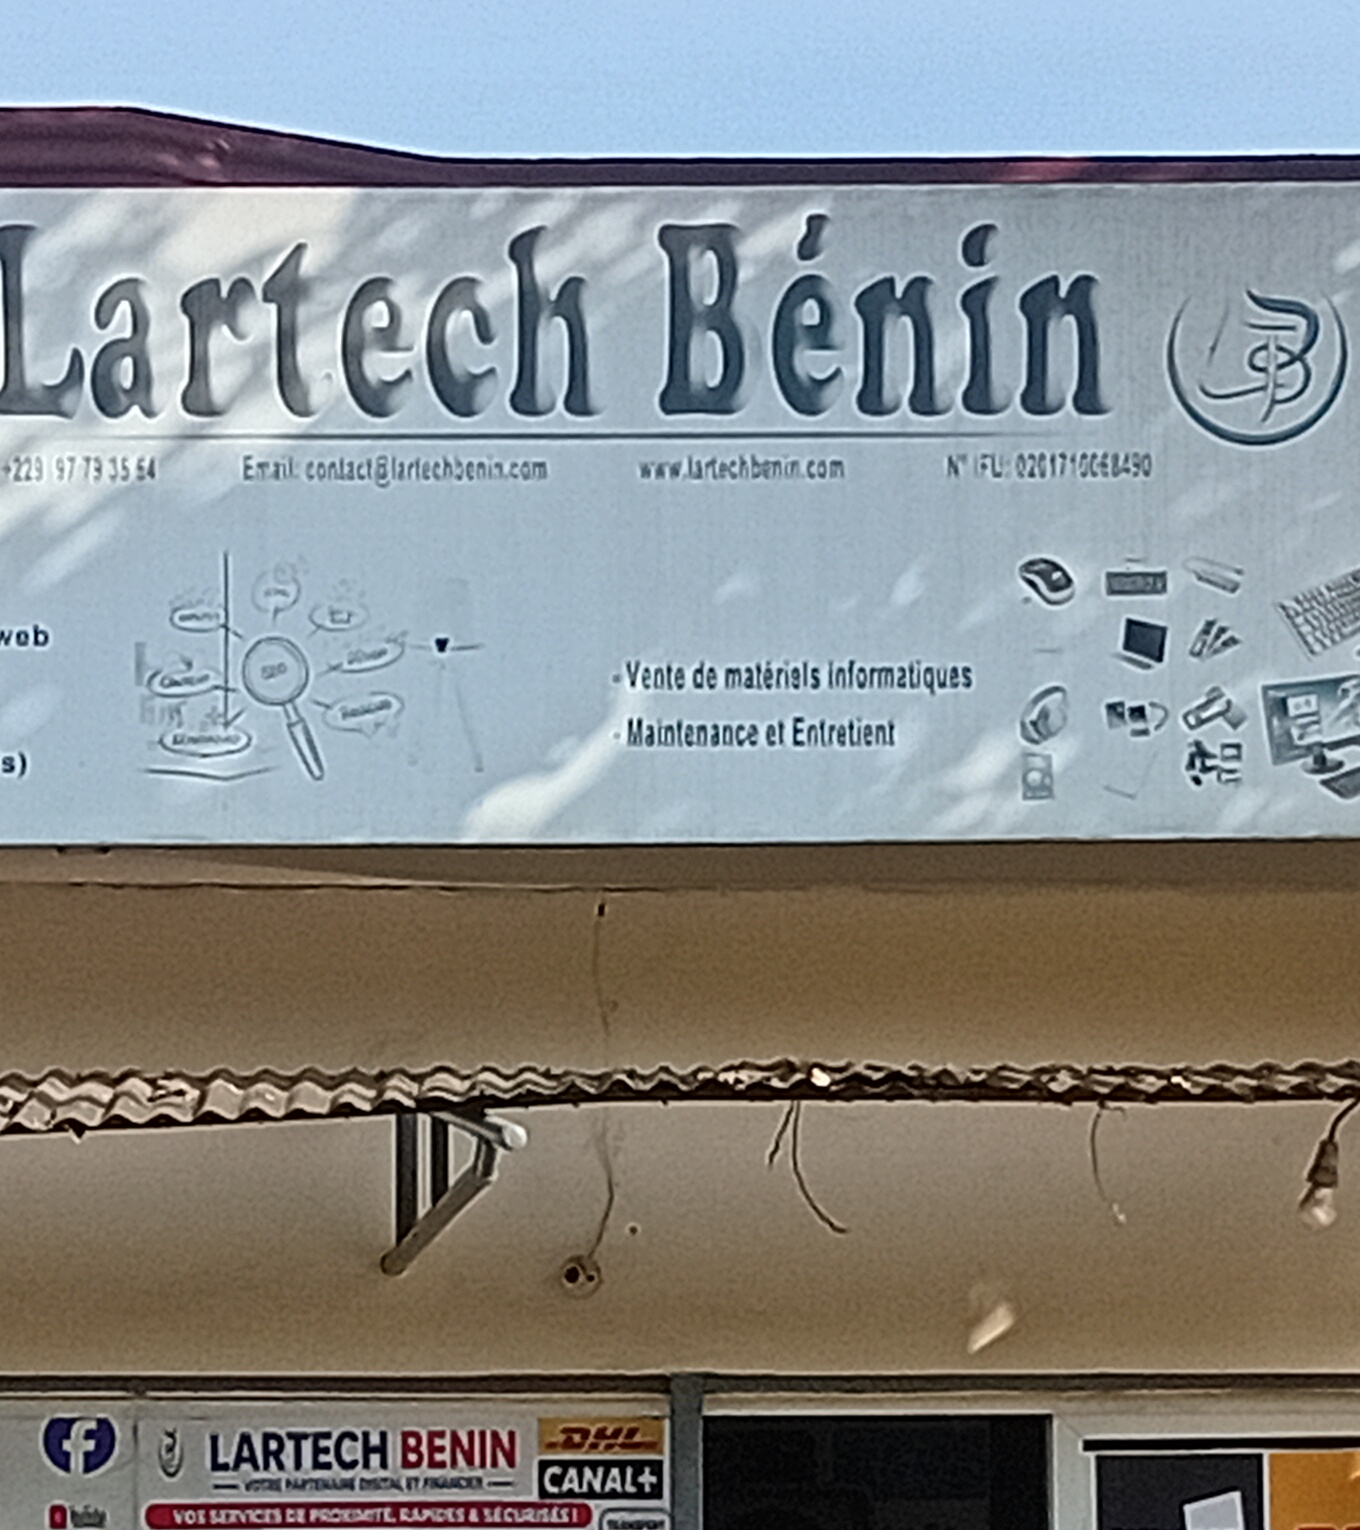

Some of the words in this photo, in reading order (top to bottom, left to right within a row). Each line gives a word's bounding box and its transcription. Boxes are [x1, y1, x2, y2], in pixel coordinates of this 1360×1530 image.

[657, 212, 1111, 417] Bénin
[625, 660, 686, 690] Vente
[692, 660, 718, 690] de
[724, 660, 821, 691] matériels
[626, 717, 759, 747] Maintenance
[765, 719, 786, 747] et
[792, 716, 895, 748] Entretient
[209, 1430, 389, 1472] LARTECH
[401, 1429, 517, 1469] BENIN
[559, 1426, 640, 1450] DHL
[543, 1465, 658, 1494] CANAL+
[173, 1509, 206, 1524] VOS
[209, 1509, 283, 1524] SERVICES
[286, 1508, 306, 1523] DE
[399, 1507, 465, 1522] RAPIDES
[468, 1508, 481, 1522] &
